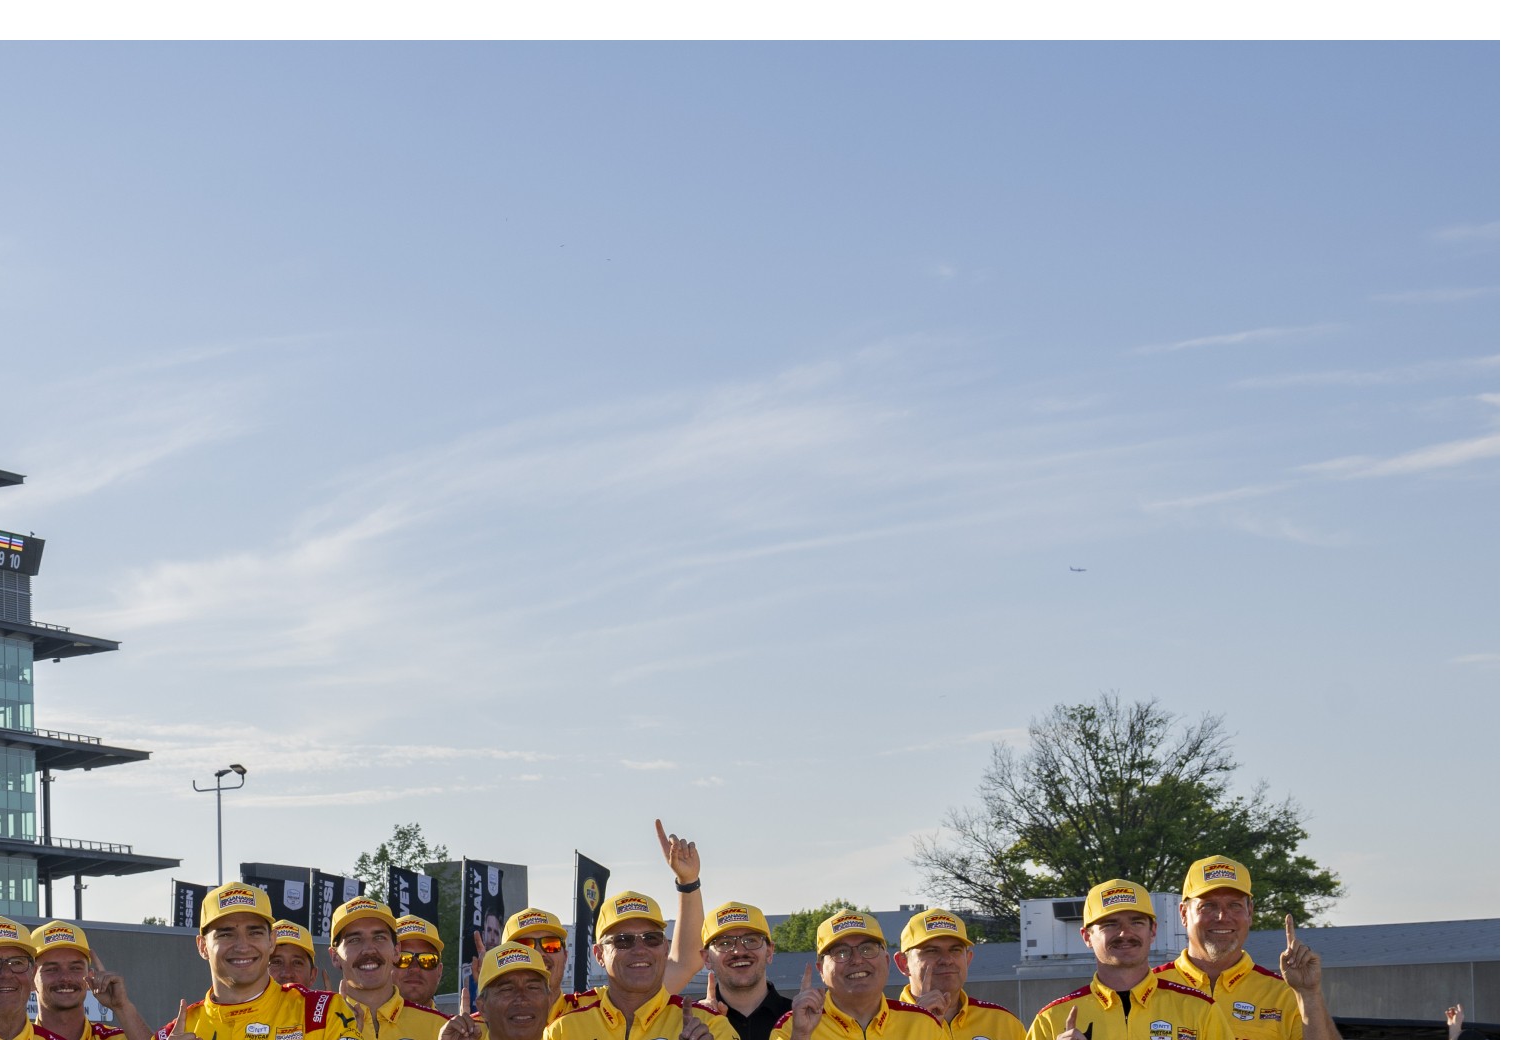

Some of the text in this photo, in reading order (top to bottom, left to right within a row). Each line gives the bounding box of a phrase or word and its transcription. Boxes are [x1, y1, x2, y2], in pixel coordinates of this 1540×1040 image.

[10, 554, 20, 569] 10
[473, 868, 482, 926] DALY
[230, 1008, 254, 1016] DHL
[313, 994, 328, 1022] sparco
